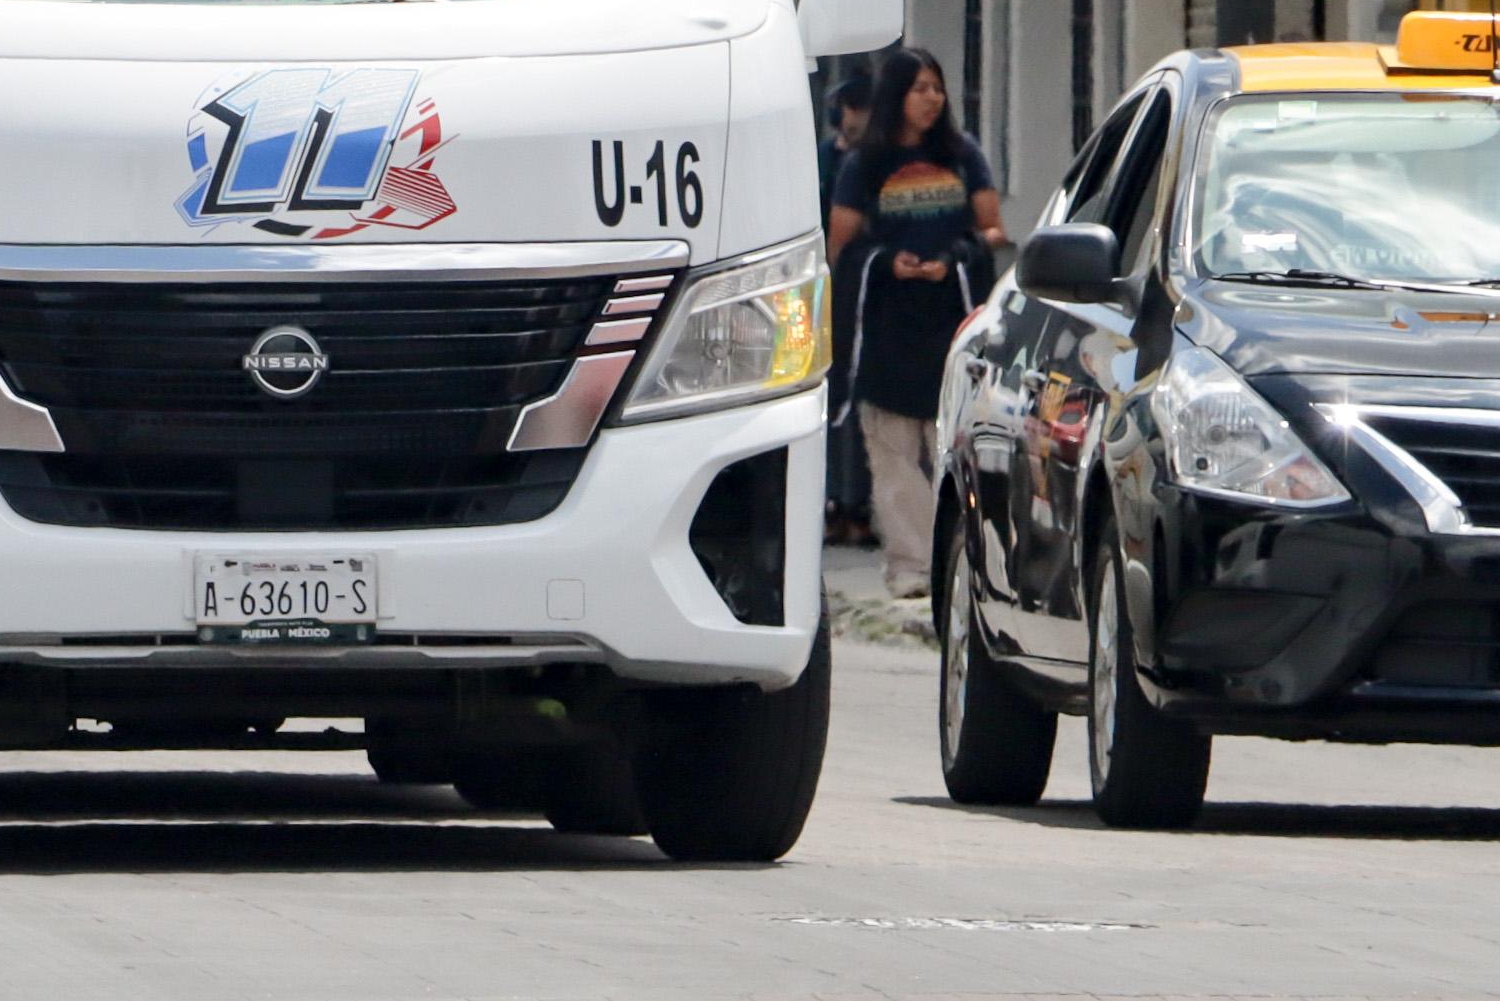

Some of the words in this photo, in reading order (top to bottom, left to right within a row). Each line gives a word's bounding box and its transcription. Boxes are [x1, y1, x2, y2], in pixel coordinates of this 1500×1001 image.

[592, 139, 703, 229] U-16
[244, 357, 327, 369] NISSAN
[204, 579, 367, 617] A-63610-S
[241, 629, 280, 639] PUEBLA
[288, 627, 330, 639] MÉXICO
